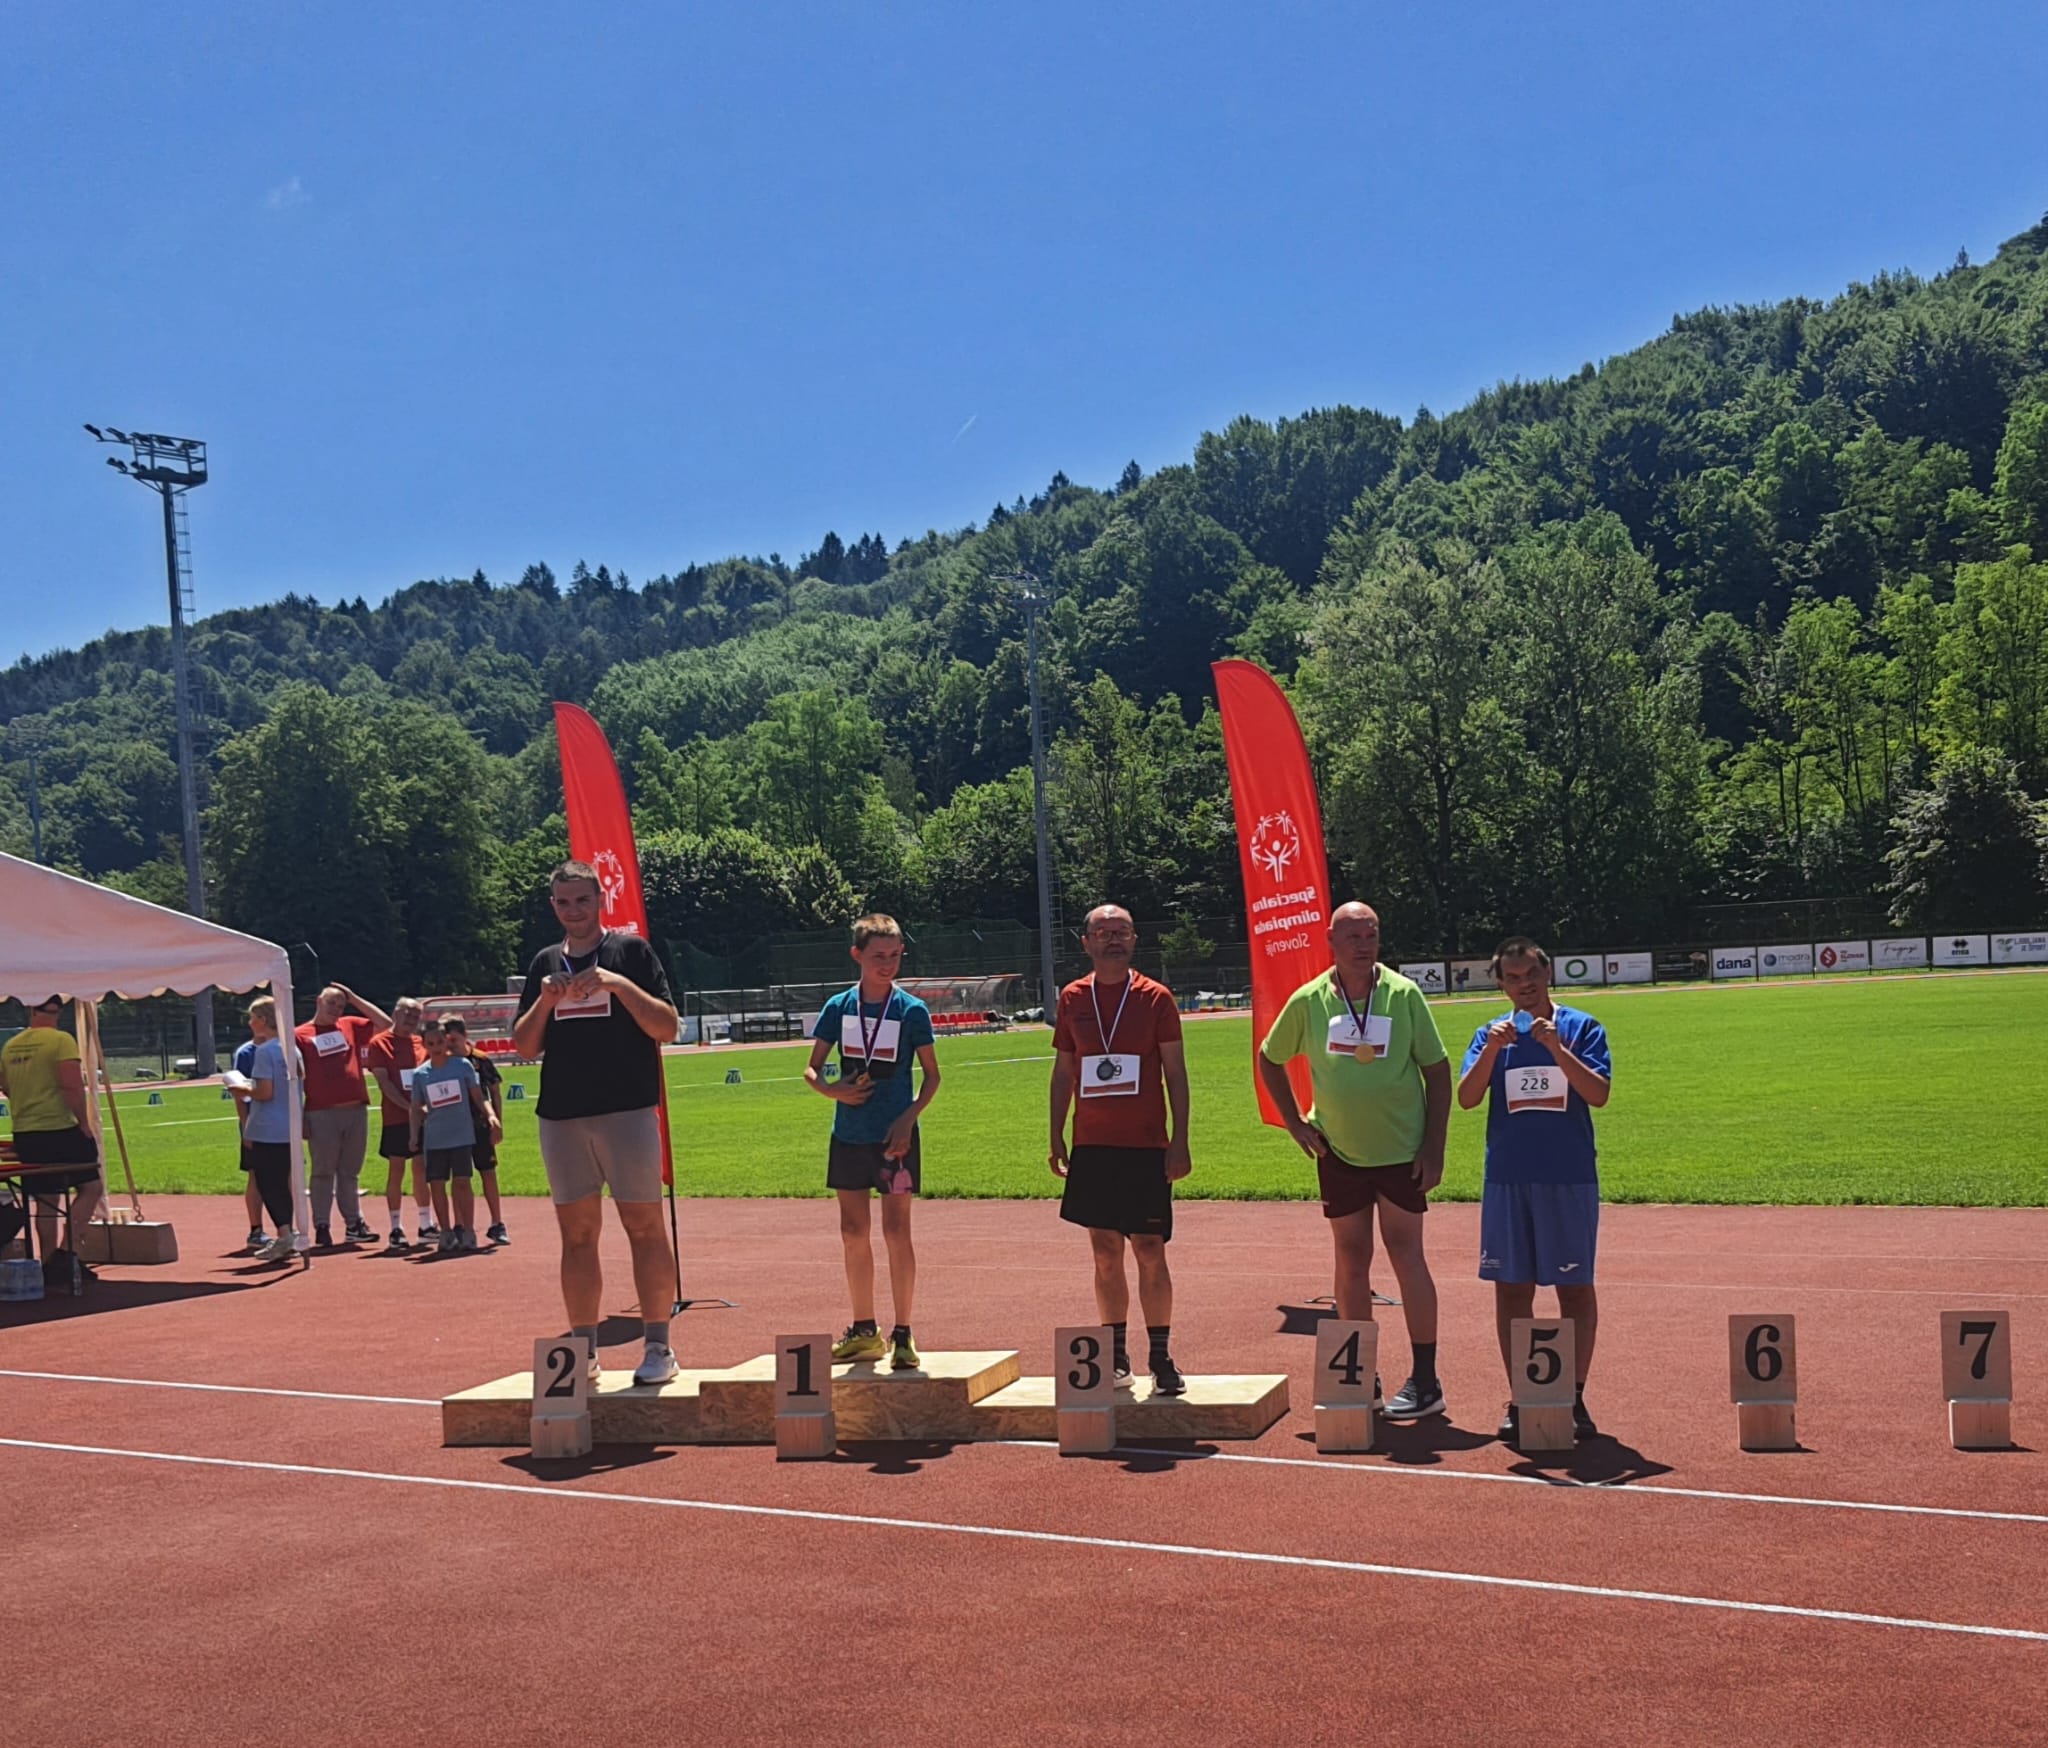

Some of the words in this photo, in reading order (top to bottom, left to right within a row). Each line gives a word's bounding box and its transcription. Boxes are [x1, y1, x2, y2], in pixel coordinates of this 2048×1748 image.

[1716, 958, 1751, 970] dana
[1520, 1077, 1549, 1091] 228
[545, 1346, 576, 1397] 2
[786, 1343, 819, 1396] 1
[1068, 1336, 1101, 1390] 3
[1329, 1331, 1364, 1385] 4
[1526, 1328, 1562, 1384] 5
[1745, 1324, 1783, 1381] 6
[1960, 1321, 1997, 1379] 7
